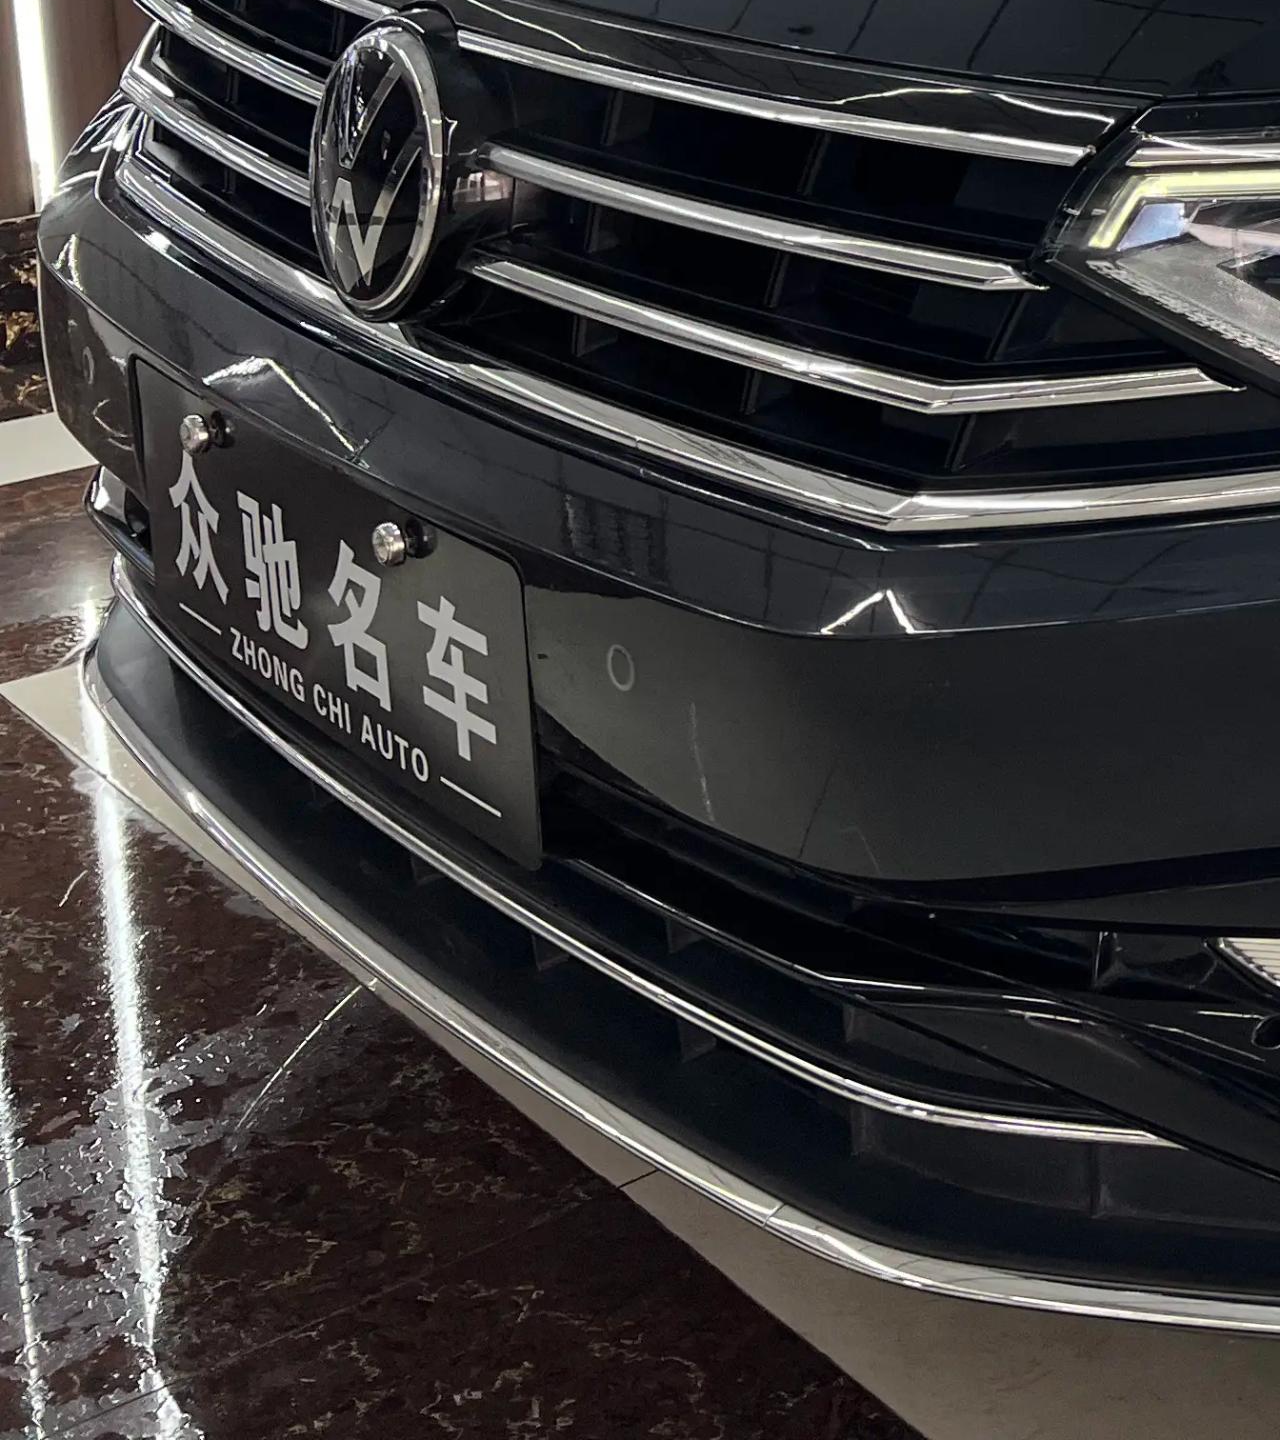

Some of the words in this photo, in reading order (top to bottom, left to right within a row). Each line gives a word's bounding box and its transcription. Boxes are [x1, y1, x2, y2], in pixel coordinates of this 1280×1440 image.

[168, 450, 497, 762] 众驰名车
[230, 626, 305, 703] ZHONG
[313, 683, 352, 734] CHI
[361, 715, 430, 782] AUTO
